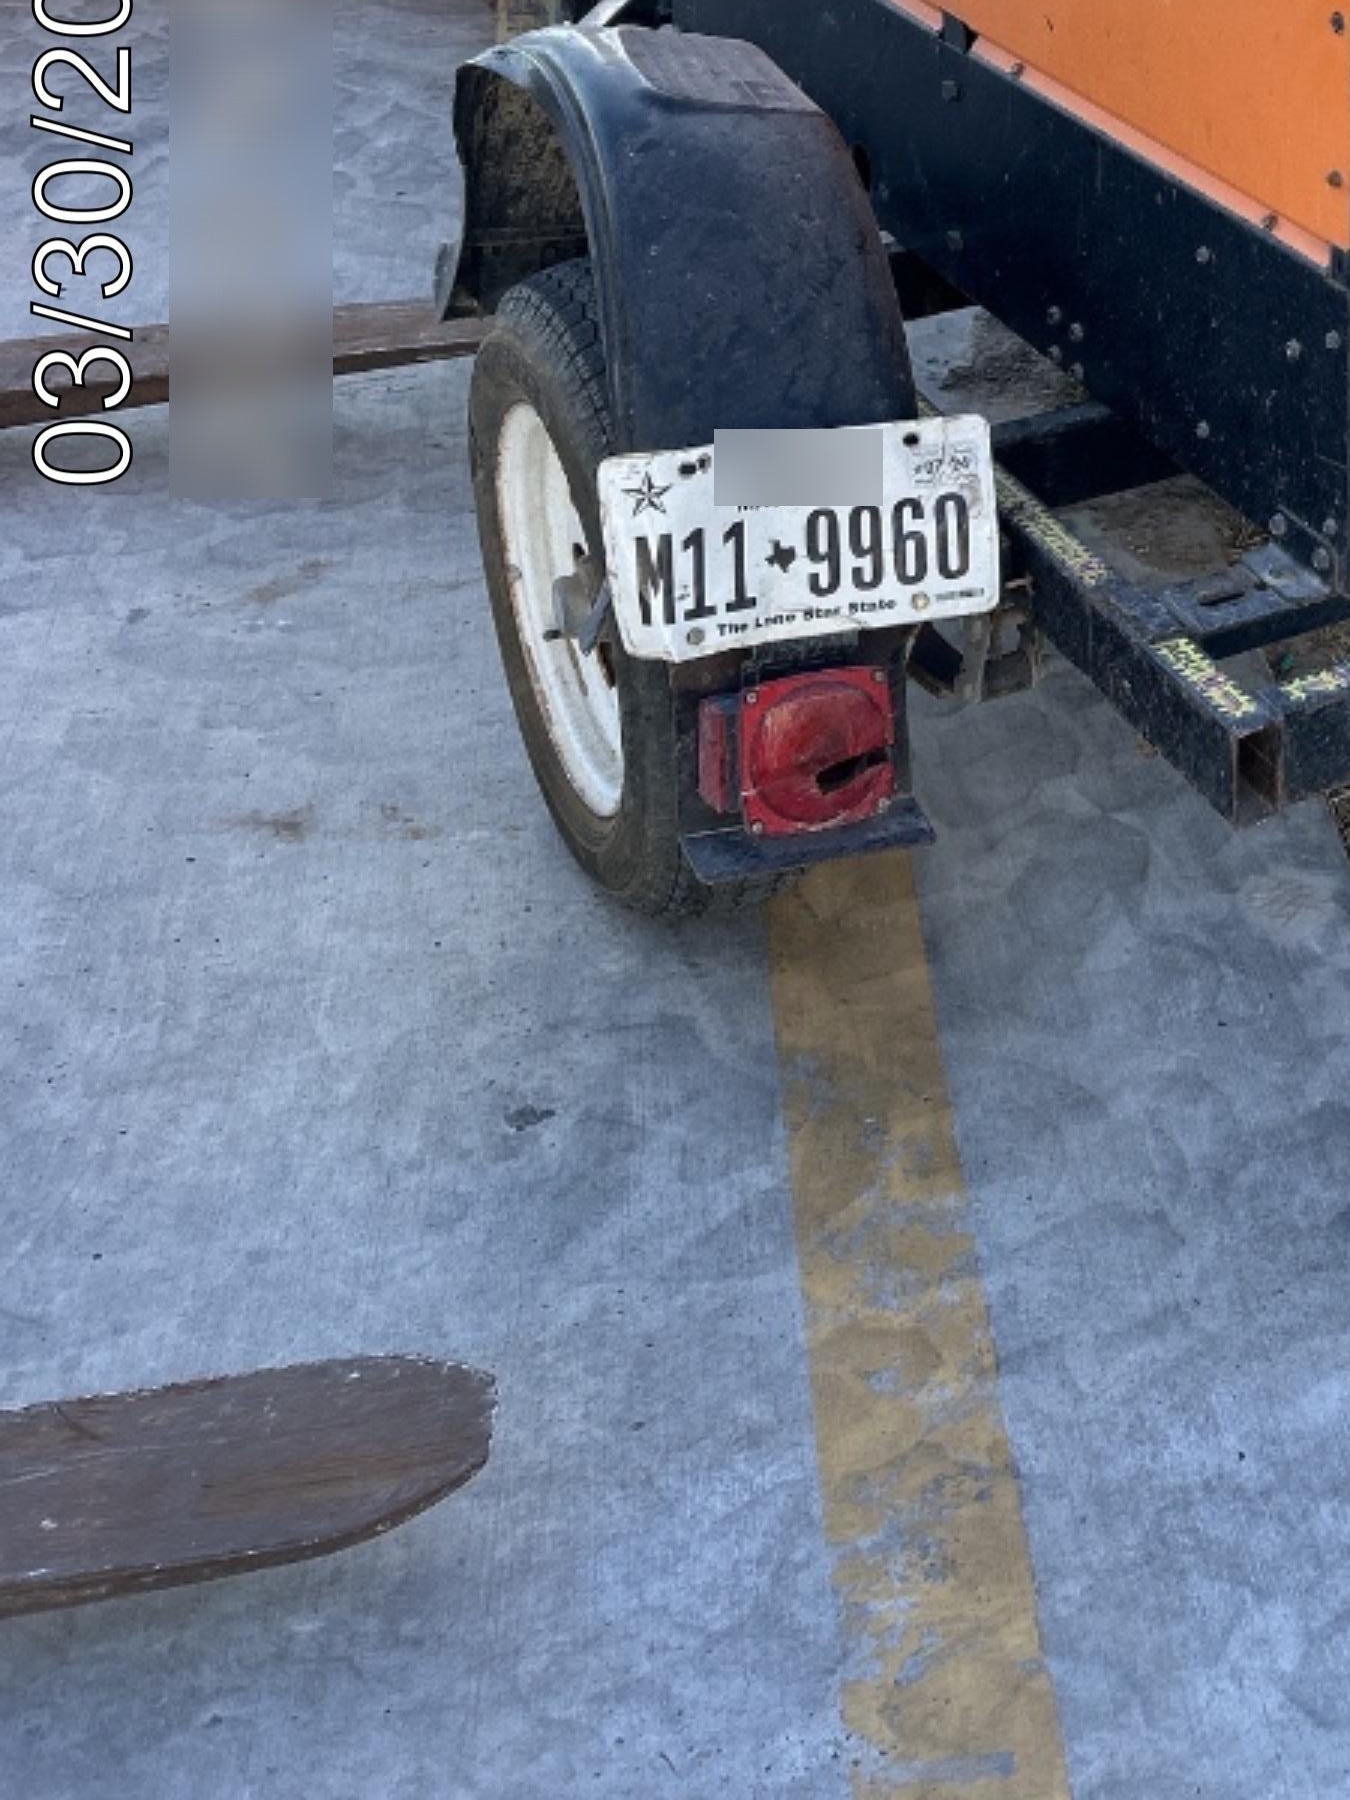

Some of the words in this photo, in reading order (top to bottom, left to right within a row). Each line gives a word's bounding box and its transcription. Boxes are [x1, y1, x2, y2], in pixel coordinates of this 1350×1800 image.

[634, 520, 757, 627] M11
[805, 492, 971, 598] 9960
[717, 622, 748, 637] The
[803, 604, 842, 622] Star
[849, 597, 896, 614] State
